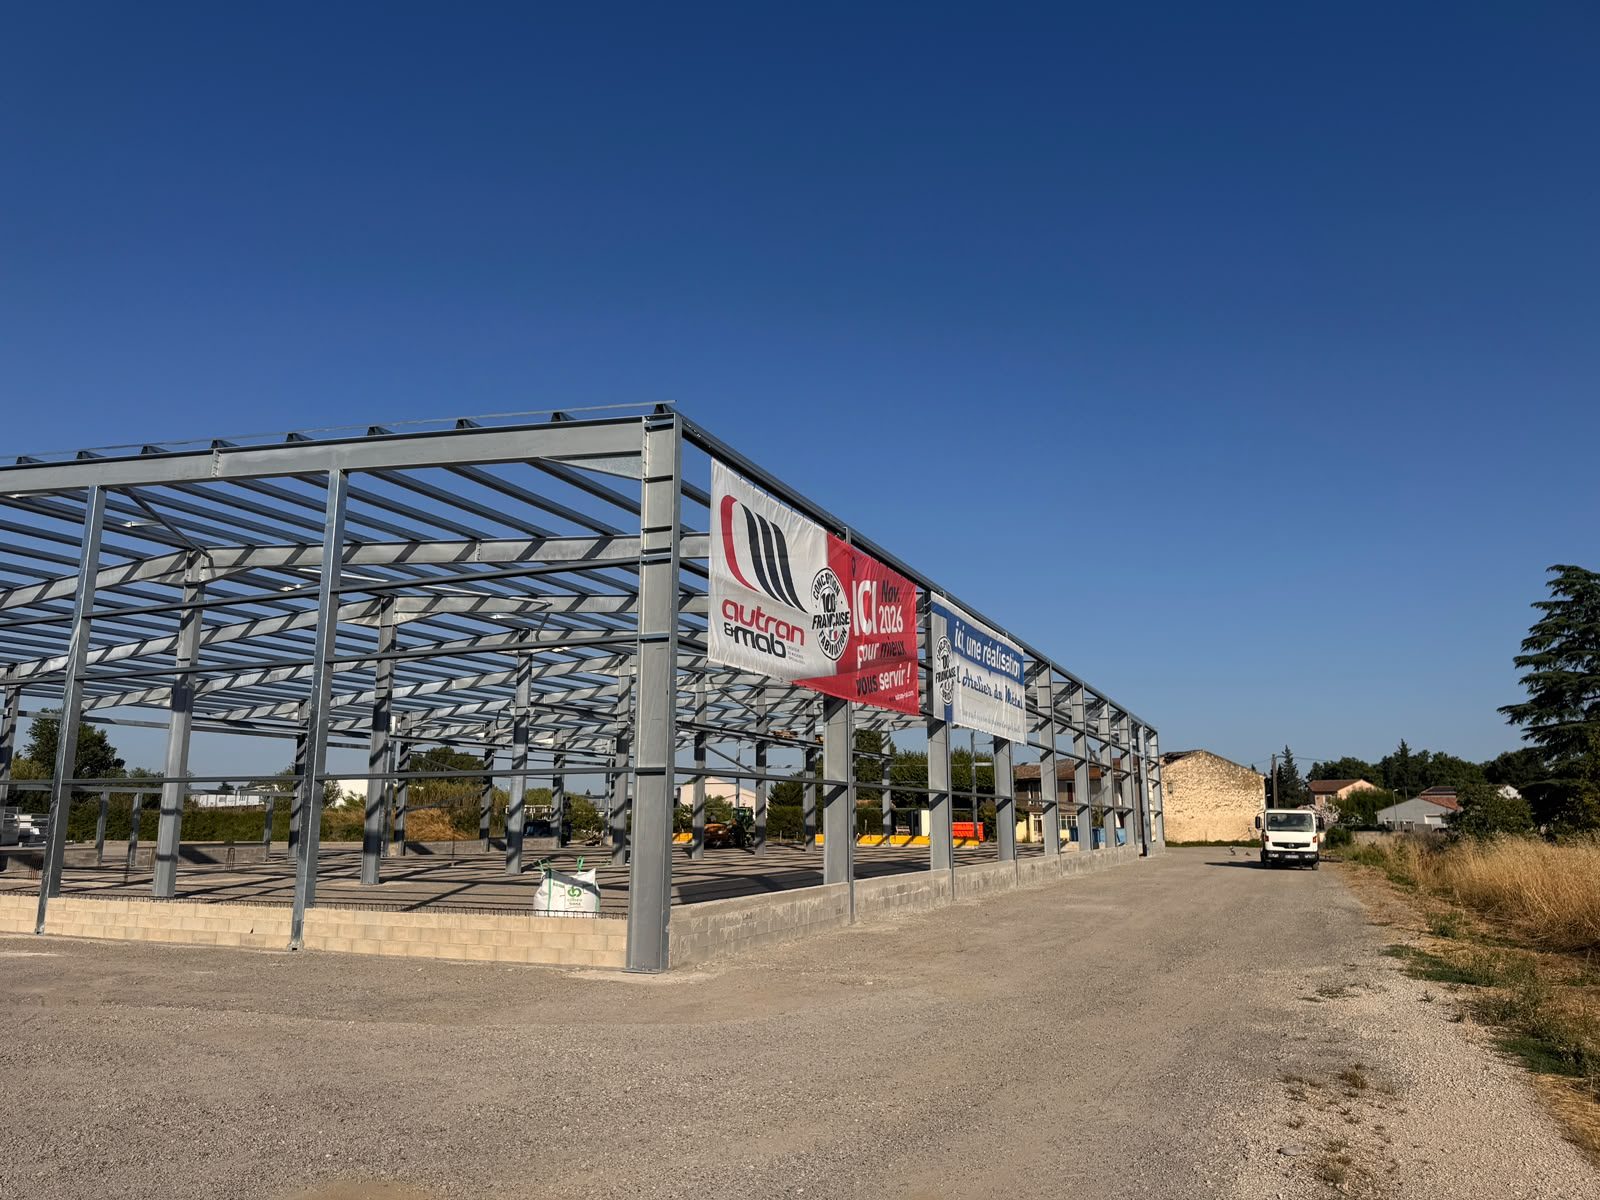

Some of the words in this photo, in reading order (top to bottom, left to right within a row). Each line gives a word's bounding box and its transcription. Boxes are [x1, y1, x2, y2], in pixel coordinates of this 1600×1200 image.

[882, 580, 900, 603] Nov.
[722, 599, 804, 646] autran
[852, 580, 878, 636] ICI
[879, 605, 904, 634] 2026
[857, 643, 880, 669] pour
[966, 636, 982, 660] une
[982, 641, 1021, 679] réalisation
[856, 674, 878, 696] vous
[879, 664, 906, 691] servir
